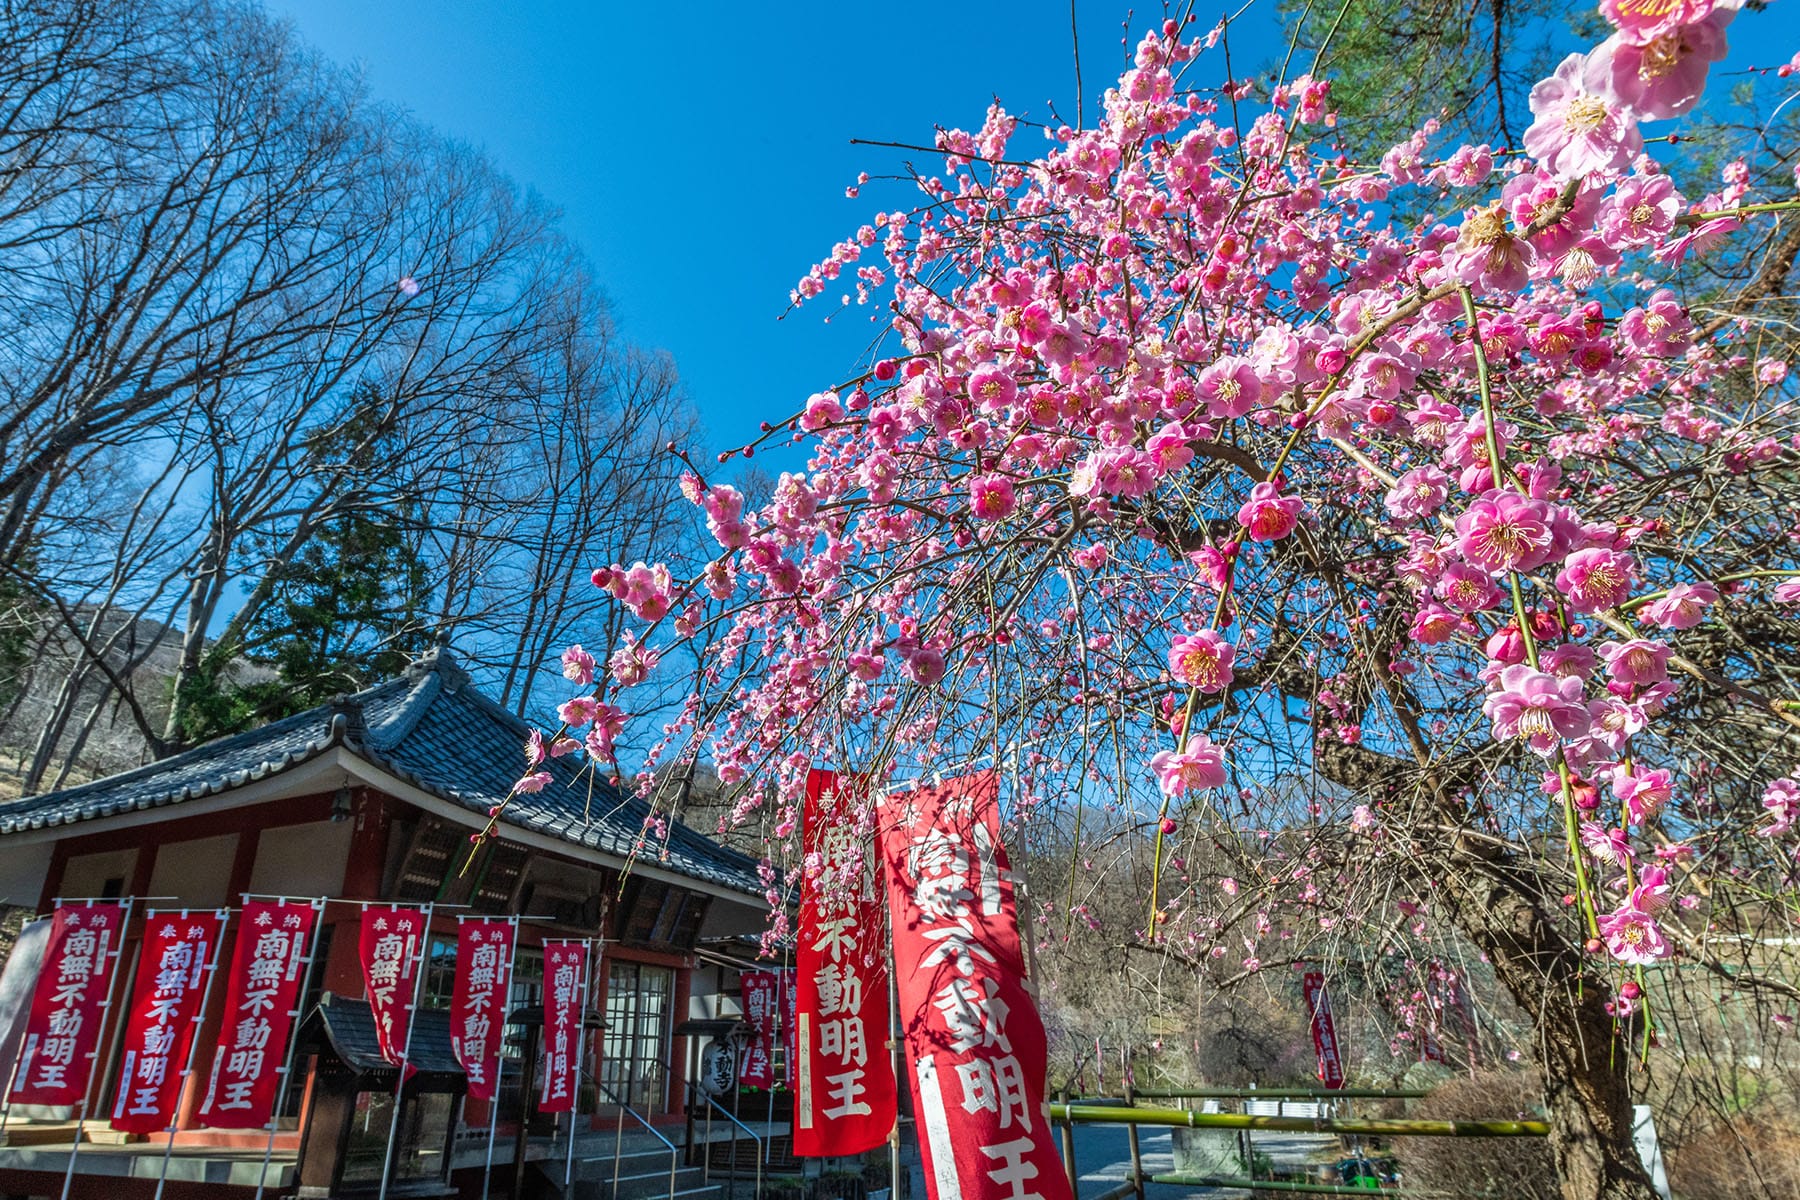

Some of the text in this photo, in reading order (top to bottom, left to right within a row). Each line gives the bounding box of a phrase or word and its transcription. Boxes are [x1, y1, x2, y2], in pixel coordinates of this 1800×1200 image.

[64, 912, 107, 927] 奉納
[159, 923, 206, 940] 奉納
[254, 911, 302, 929] 奉納
[373, 917, 412, 933] 奉納
[469, 930, 504, 942] 奉納
[32, 928, 97, 1089] 南無不動明王
[128, 940, 193, 1116] 南無不動明王
[218, 929, 290, 1111] 南無不動明王
[463, 943, 497, 1085] 南無不動明王
[552, 964, 574, 1099] 南無不動明王
